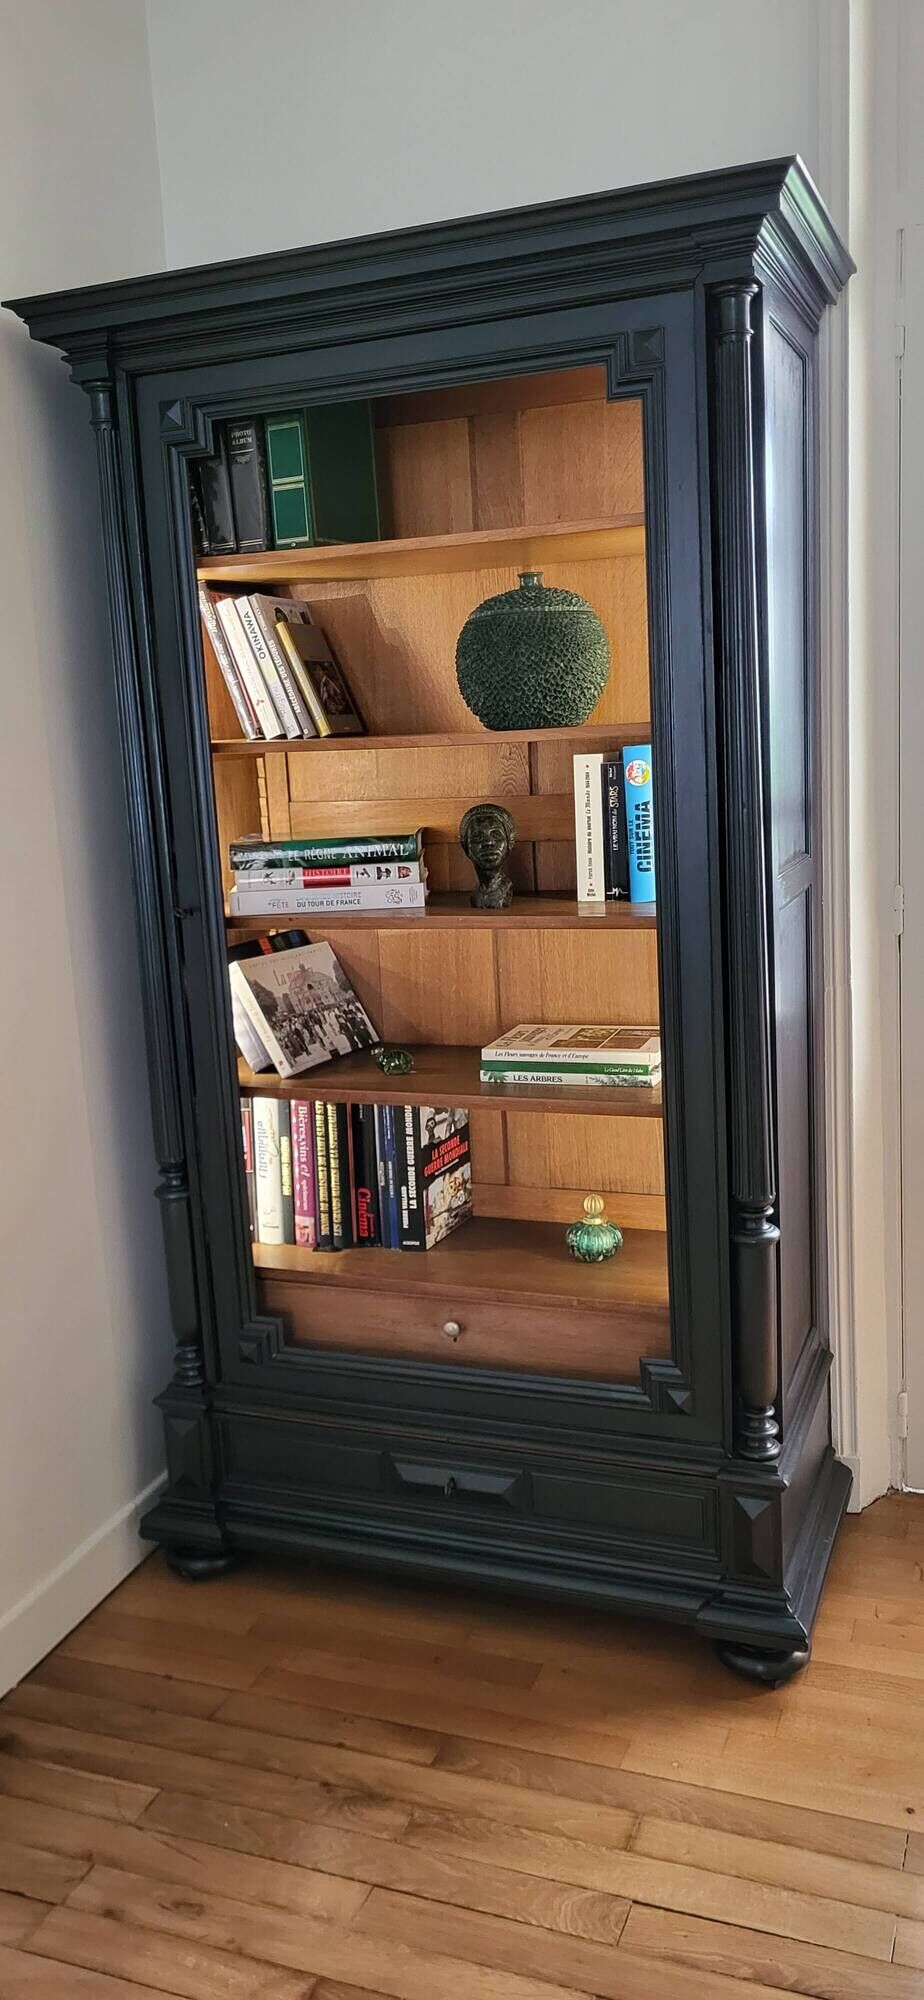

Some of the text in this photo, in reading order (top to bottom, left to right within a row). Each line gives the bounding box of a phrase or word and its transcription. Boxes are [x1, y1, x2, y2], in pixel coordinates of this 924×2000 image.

[243, 611, 266, 660] OKINAWA
[608, 785, 619, 807] STARS
[288, 851, 296, 862] LE
[342, 843, 409, 859] ANIMAL
[307, 900, 325, 908] TOUR
[336, 898, 361, 906] FRANCE
[513, 1074, 563, 1083] LES ARBRES
[404, 1105, 417, 1209] LA SECONDE GUERRE MONDIA
